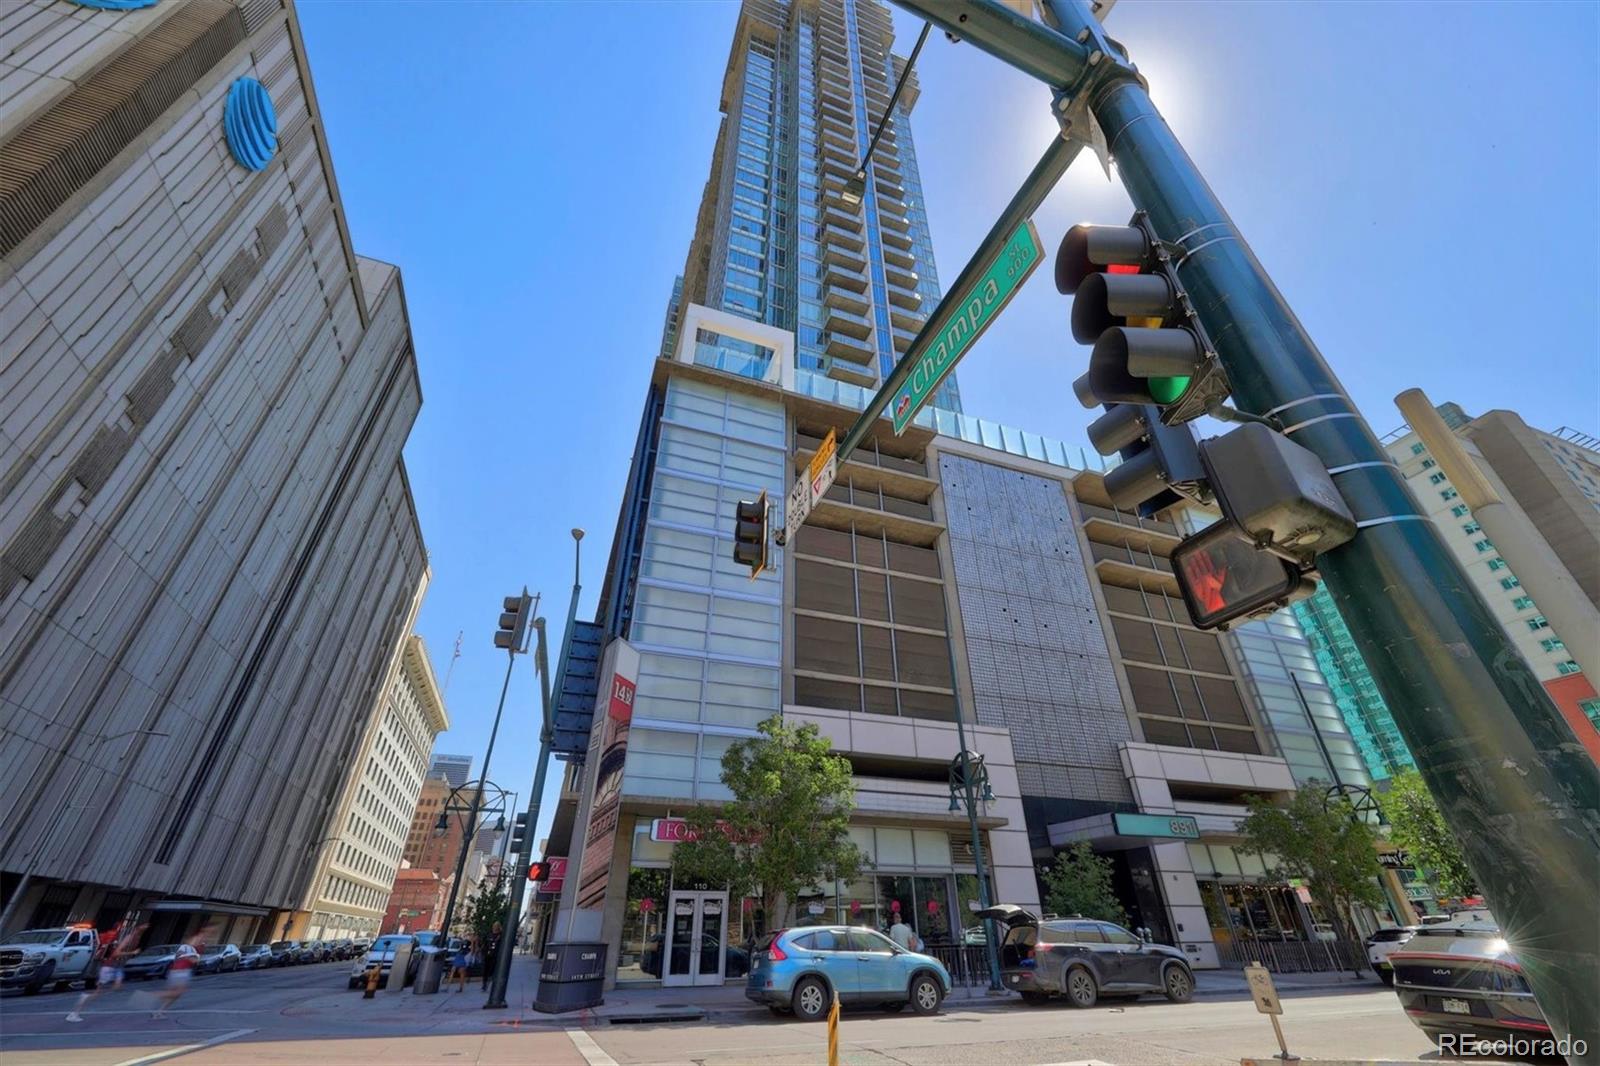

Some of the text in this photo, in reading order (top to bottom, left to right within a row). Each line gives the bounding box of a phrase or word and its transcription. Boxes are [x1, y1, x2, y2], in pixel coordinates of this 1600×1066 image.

[1007, 247, 1030, 277] 900
[911, 277, 999, 394] Champa
[694, 882, 708, 890] 110
